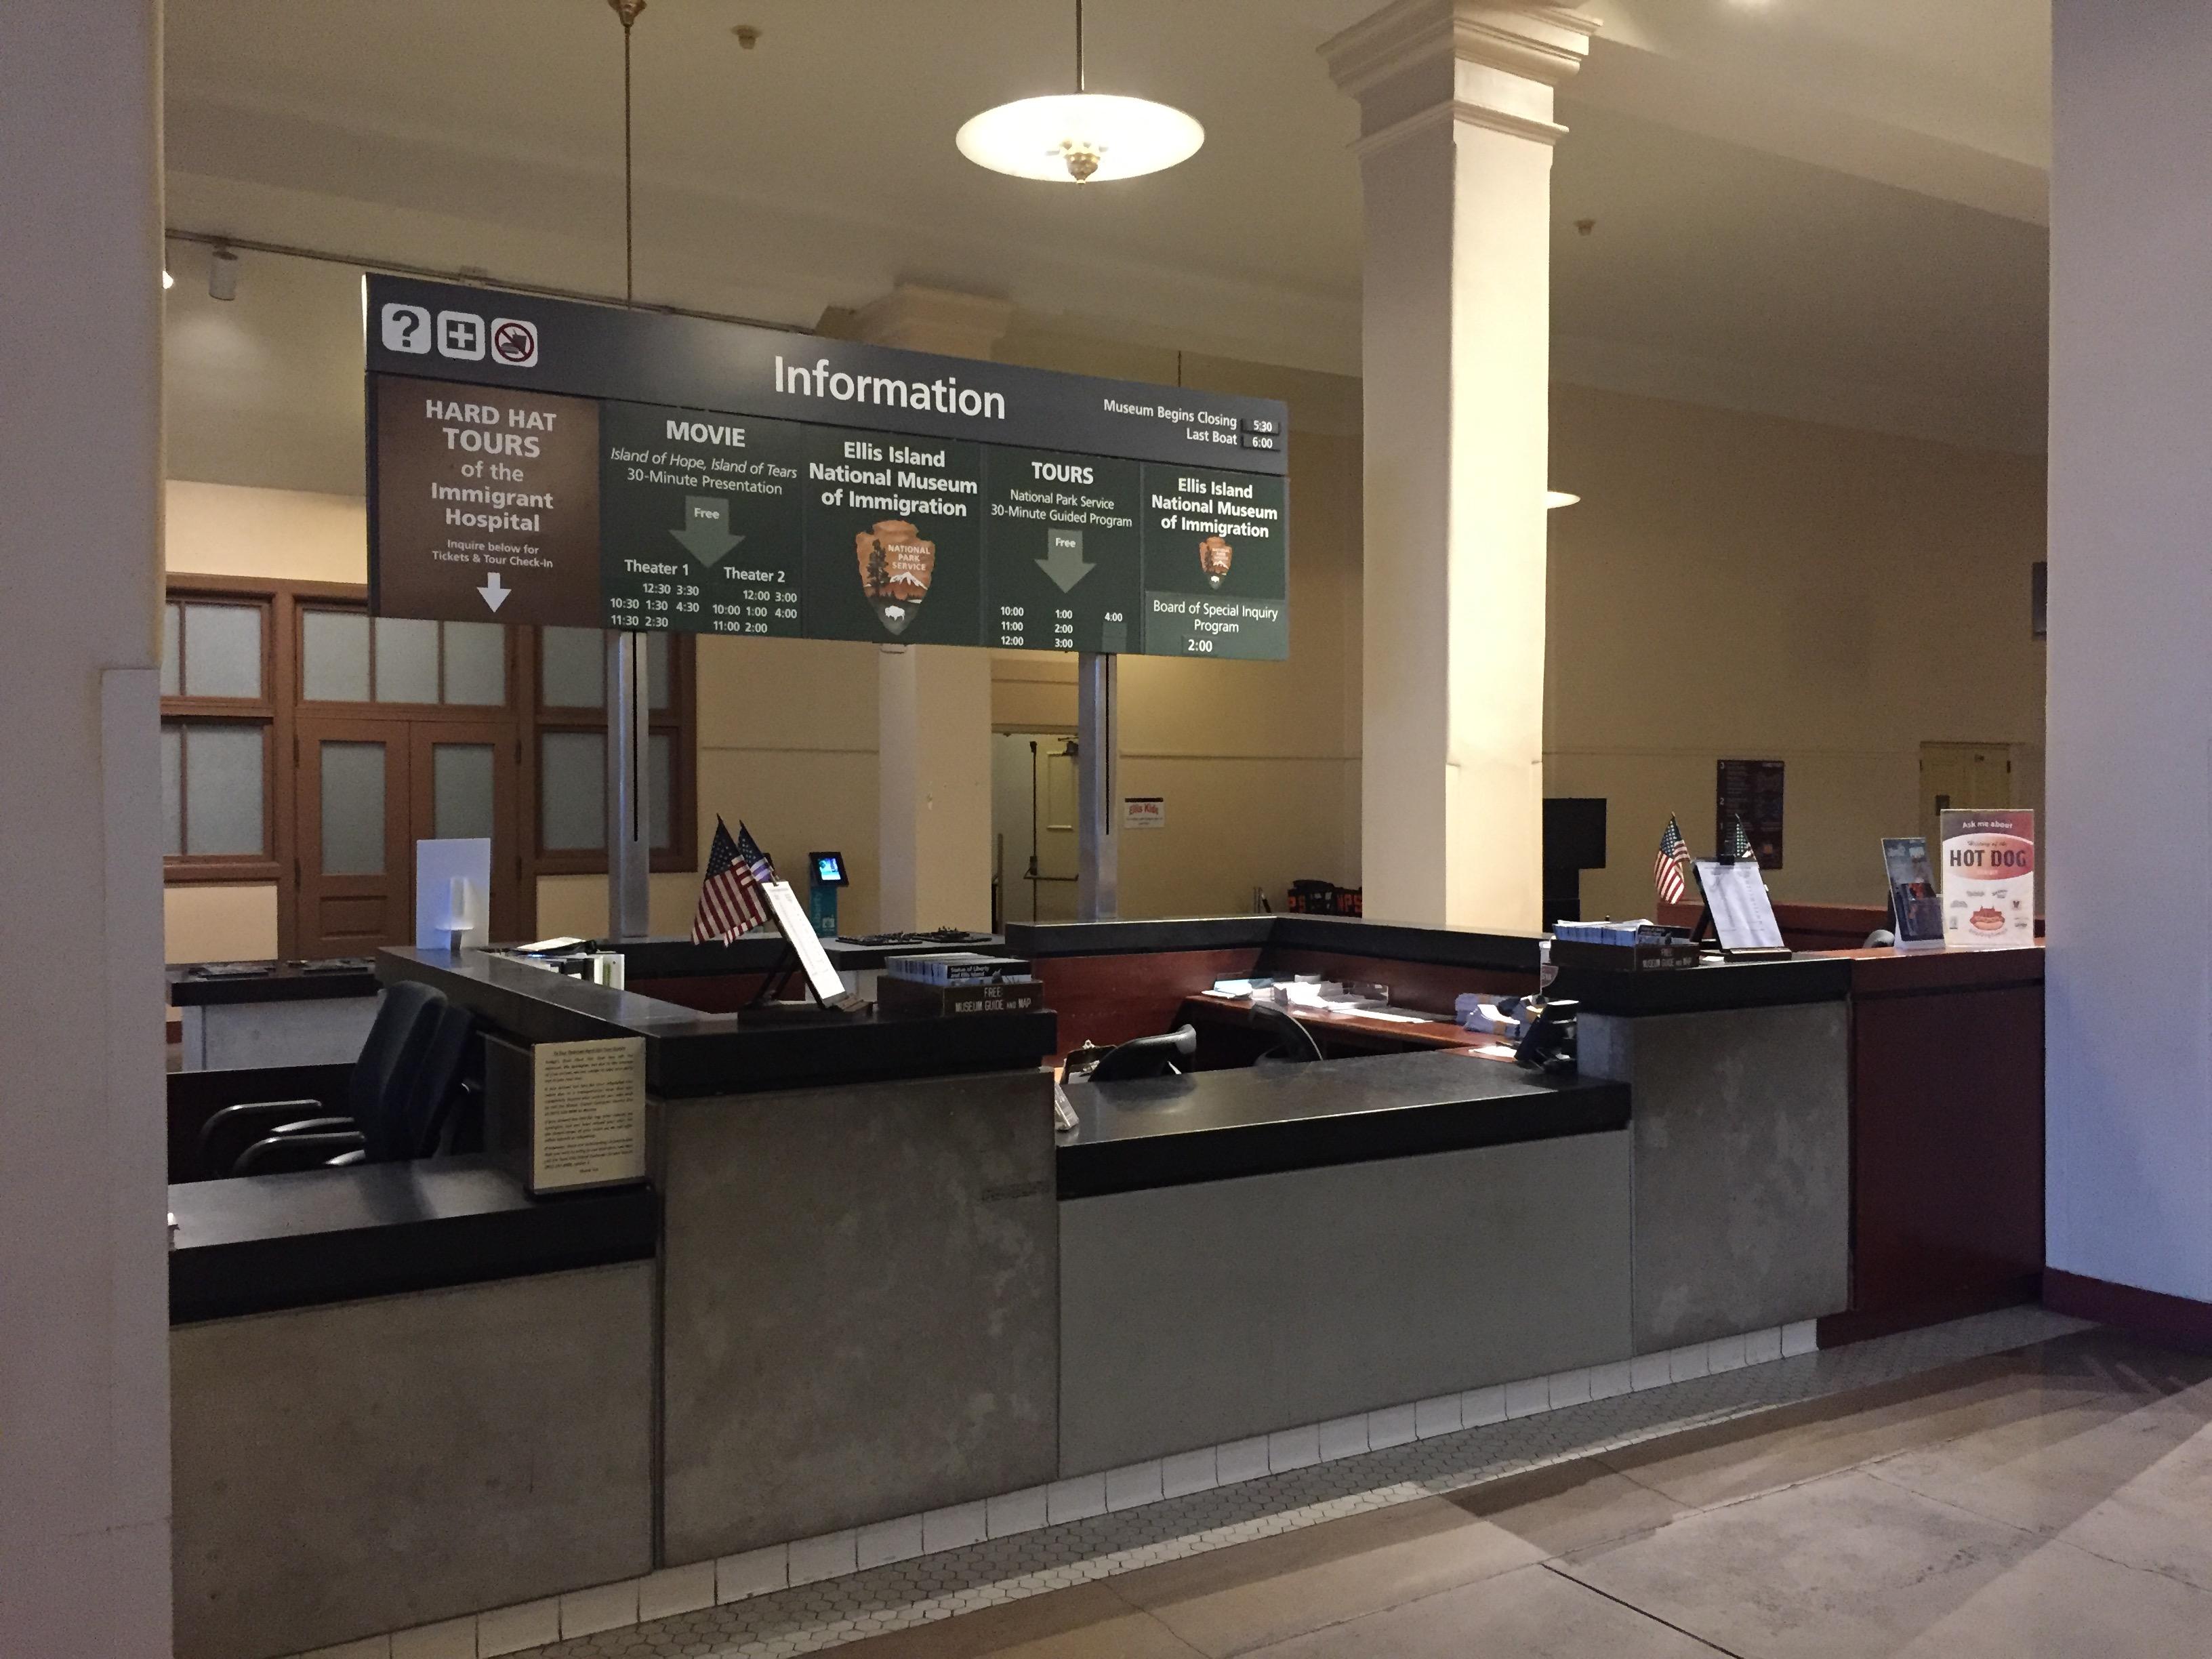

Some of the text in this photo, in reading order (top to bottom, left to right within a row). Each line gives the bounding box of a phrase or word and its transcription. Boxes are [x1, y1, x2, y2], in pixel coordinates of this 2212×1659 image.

[775, 355, 1005, 419] Information
[426, 399, 557, 431] HARD HAT
[1103, 398, 1273, 432] Museum Begins Closing 5:30
[666, 419, 745, 447] MOVIE
[1186, 428, 1273, 449] Last Boat 6:00
[443, 428, 541, 458] TOURS
[611, 447, 797, 479] Island of Hope, Island of Tears
[844, 441, 945, 468] Ellis Island
[461, 460, 524, 482] of the
[809, 462, 977, 494] National Museum
[1031, 462, 1094, 485] TOURS
[627, 468, 782, 495] 30-Minute Presentation
[1178, 478, 1253, 499] Ellis Island
[431, 482, 554, 510] Immigrant
[821, 488, 967, 517] of Immigration
[1010, 489, 1114, 510] National Park Service
[694, 507, 720, 519] Free
[1152, 494, 1277, 520] National Museum
[445, 508, 539, 533] Hospital
[991, 504, 1132, 529] 30-Minute Guided Program
[1161, 514, 1269, 538] of Immigration
[447, 539, 539, 554] Inquire below for
[888, 544, 930, 554] NATIONAL
[1055, 537, 1076, 548] Free
[432, 550, 554, 569] Tickets & Tour Check-In
[891, 561, 926, 571] SERVICE
[898, 553, 920, 562] PARK
[624, 558, 689, 576] Theater 1
[723, 566, 785, 583] Theater 2
[642, 583, 699, 596] 12:30 3:30
[743, 590, 797, 603] 12:00 3:00
[610, 598, 700, 613] 10:30 1:30 4:30
[712, 604, 798, 619] 10:00 1:00 4:00
[1000, 607, 1123, 622] 10:00 1:00 4:00
[1153, 600, 1279, 621] Board of Special Inquiry
[611, 615, 669, 628] 11:30 2:30
[713, 621, 768, 633] 11:00 2:00
[1000, 621, 1073, 634] 11:00 2:00
[1194, 619, 1240, 635] Program
[1000, 636, 1073, 648] 12:00 3:00
[1188, 639, 1213, 653] 2:00
[1962, 821, 1976, 829] Ask
[1990, 820, 2013, 829] about
[1950, 849, 2026, 867] HOT DOG
[984, 987, 1002, 998] FREE
[955, 1001, 983, 1012] MUSEUM
[985, 1000, 1004, 1011] GUIDE
[1018, 998, 1031, 1008] MAP
